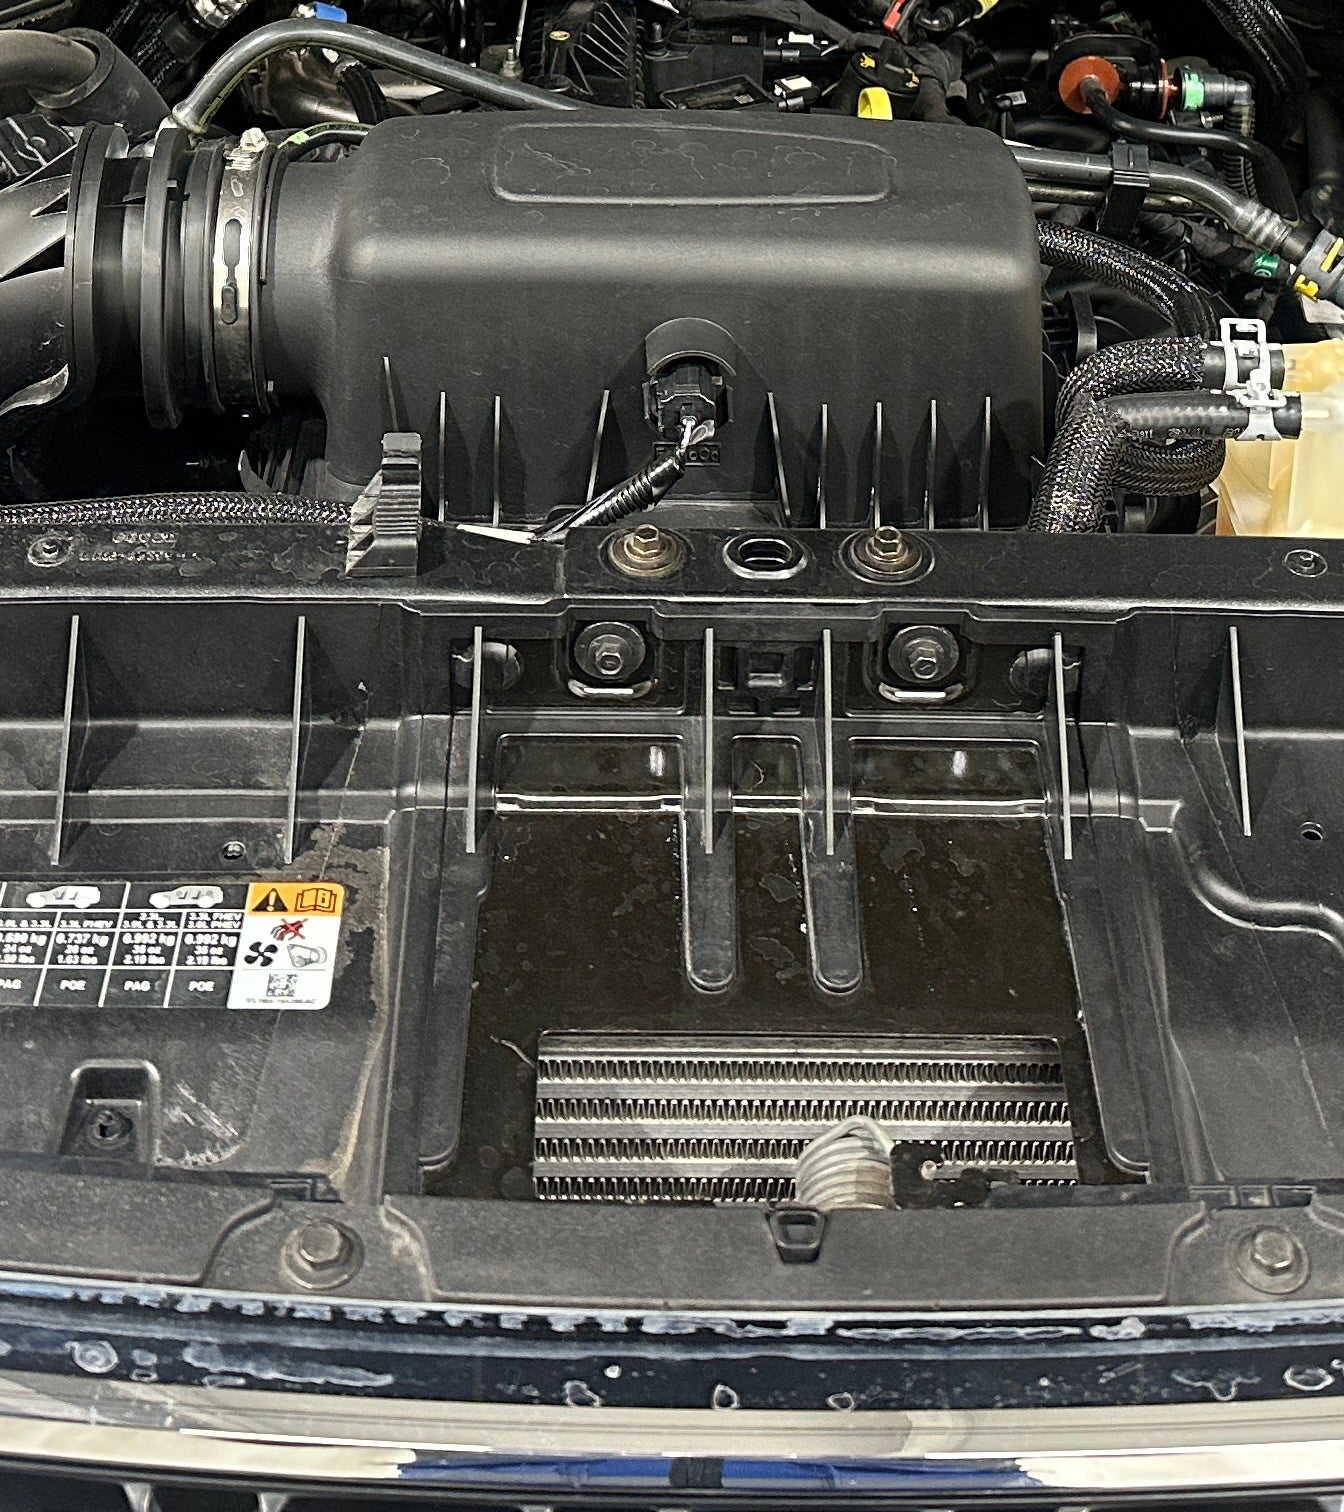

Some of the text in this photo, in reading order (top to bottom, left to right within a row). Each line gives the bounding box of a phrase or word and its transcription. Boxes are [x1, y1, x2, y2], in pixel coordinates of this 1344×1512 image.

[30, 932, 47, 946] kg
[56, 932, 109, 947] 0.737 kg
[158, 933, 176, 946] kg
[220, 933, 237, 947] kg
[59, 979, 87, 990] POE
[188, 980, 215, 991] POE
